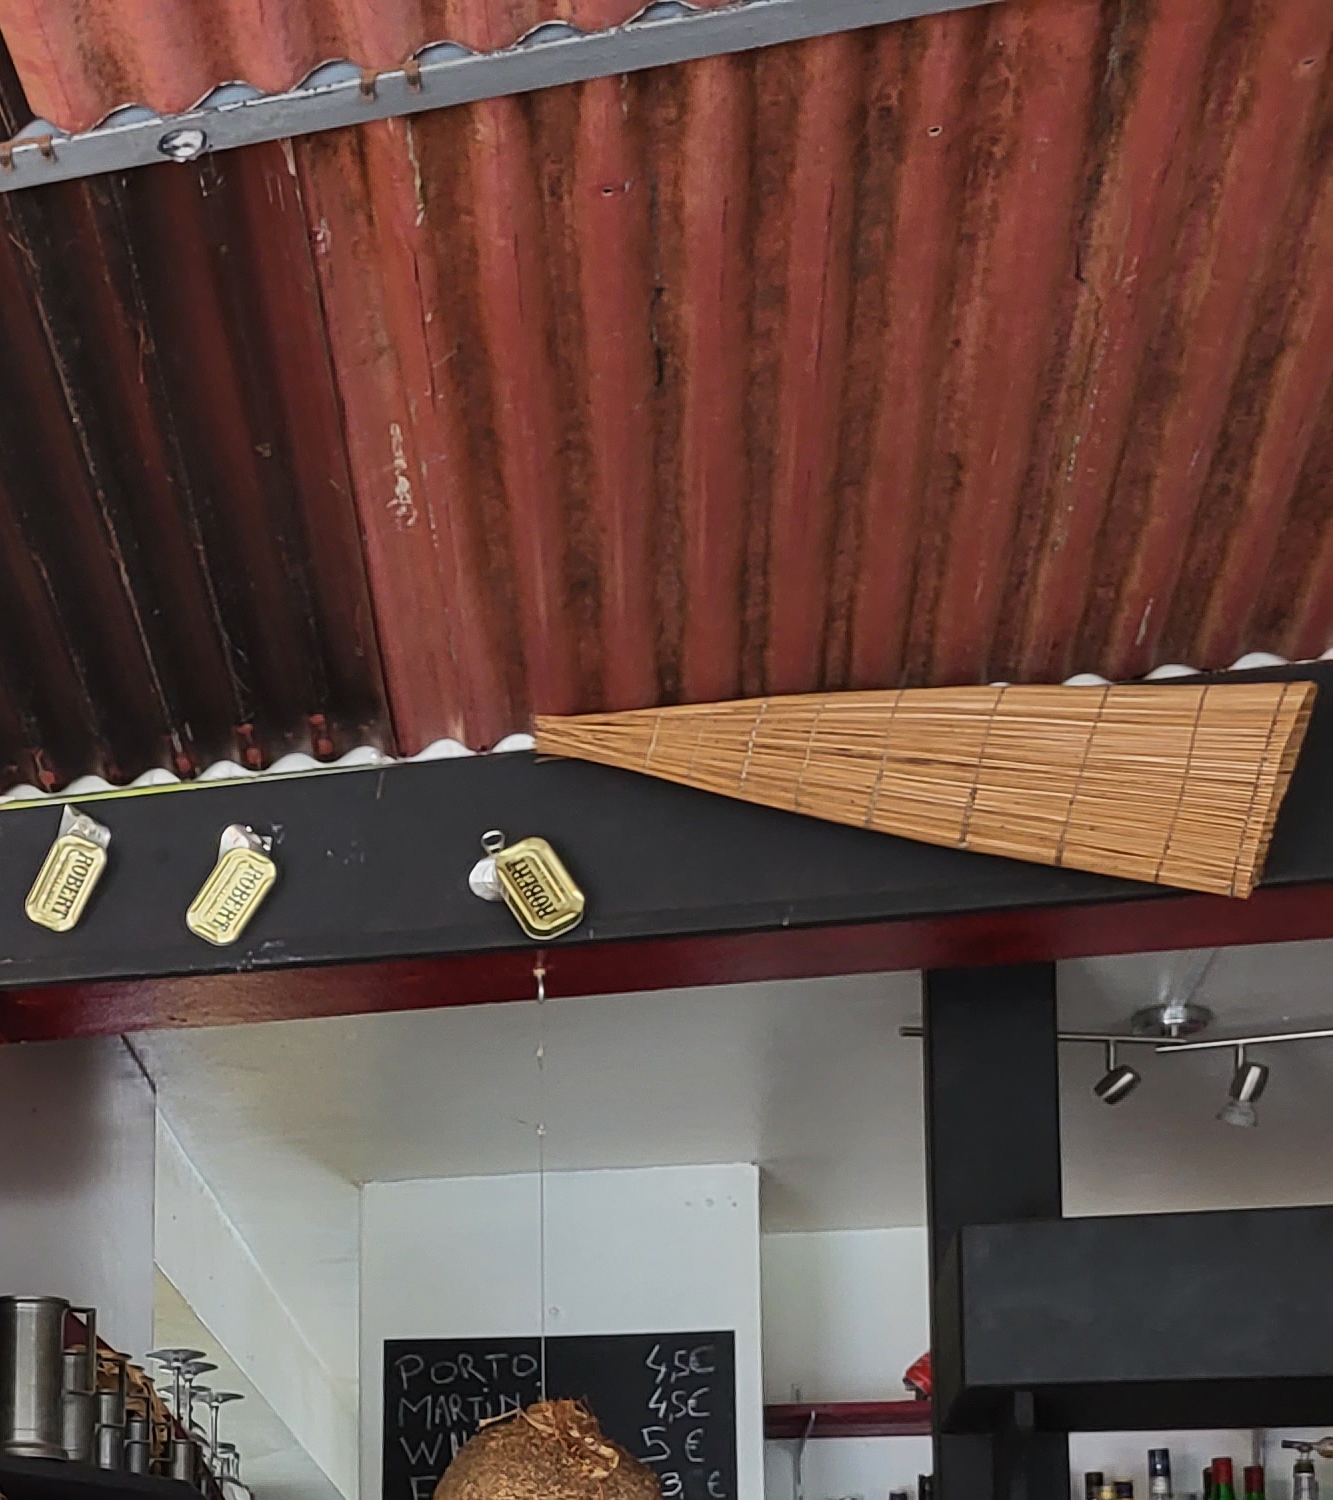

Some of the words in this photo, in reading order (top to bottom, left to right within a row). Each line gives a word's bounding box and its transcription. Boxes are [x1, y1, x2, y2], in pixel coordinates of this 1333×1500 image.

[51, 851, 94, 920] ROBERT
[213, 862, 263, 932] ROBERT
[504, 858, 557, 920] ROBERT
[394, 1353, 538, 1391] PORTO
